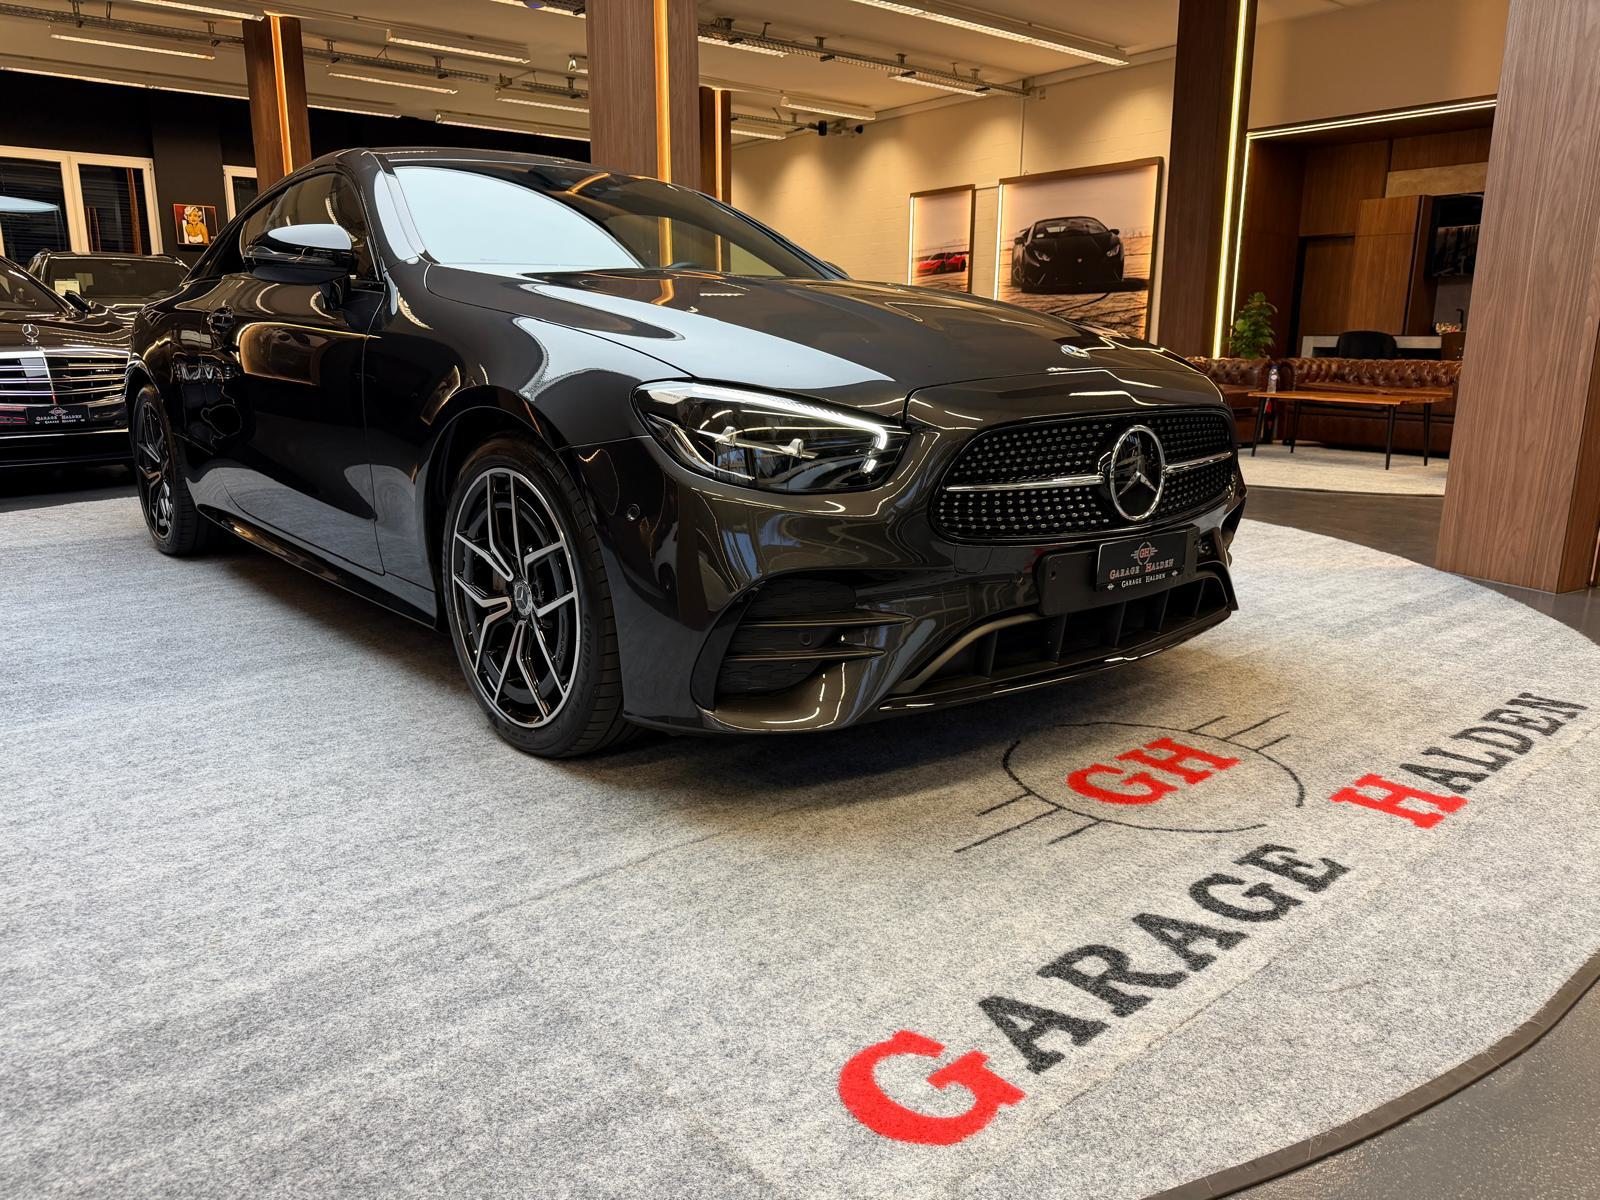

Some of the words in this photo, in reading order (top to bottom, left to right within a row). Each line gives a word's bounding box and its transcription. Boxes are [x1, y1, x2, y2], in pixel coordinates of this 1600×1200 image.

[1139, 547, 1151, 558] GH
[1109, 565, 1140, 580] GARAGE
[1145, 558, 1174, 573] HALDEN
[1121, 578, 1142, 588] GARAGE
[1145, 573, 1166, 583] HALDEN
[1066, 737, 1241, 805] GH
[838, 842, 1350, 1146] GARAGE
[1330, 691, 1589, 829] HALDEN
